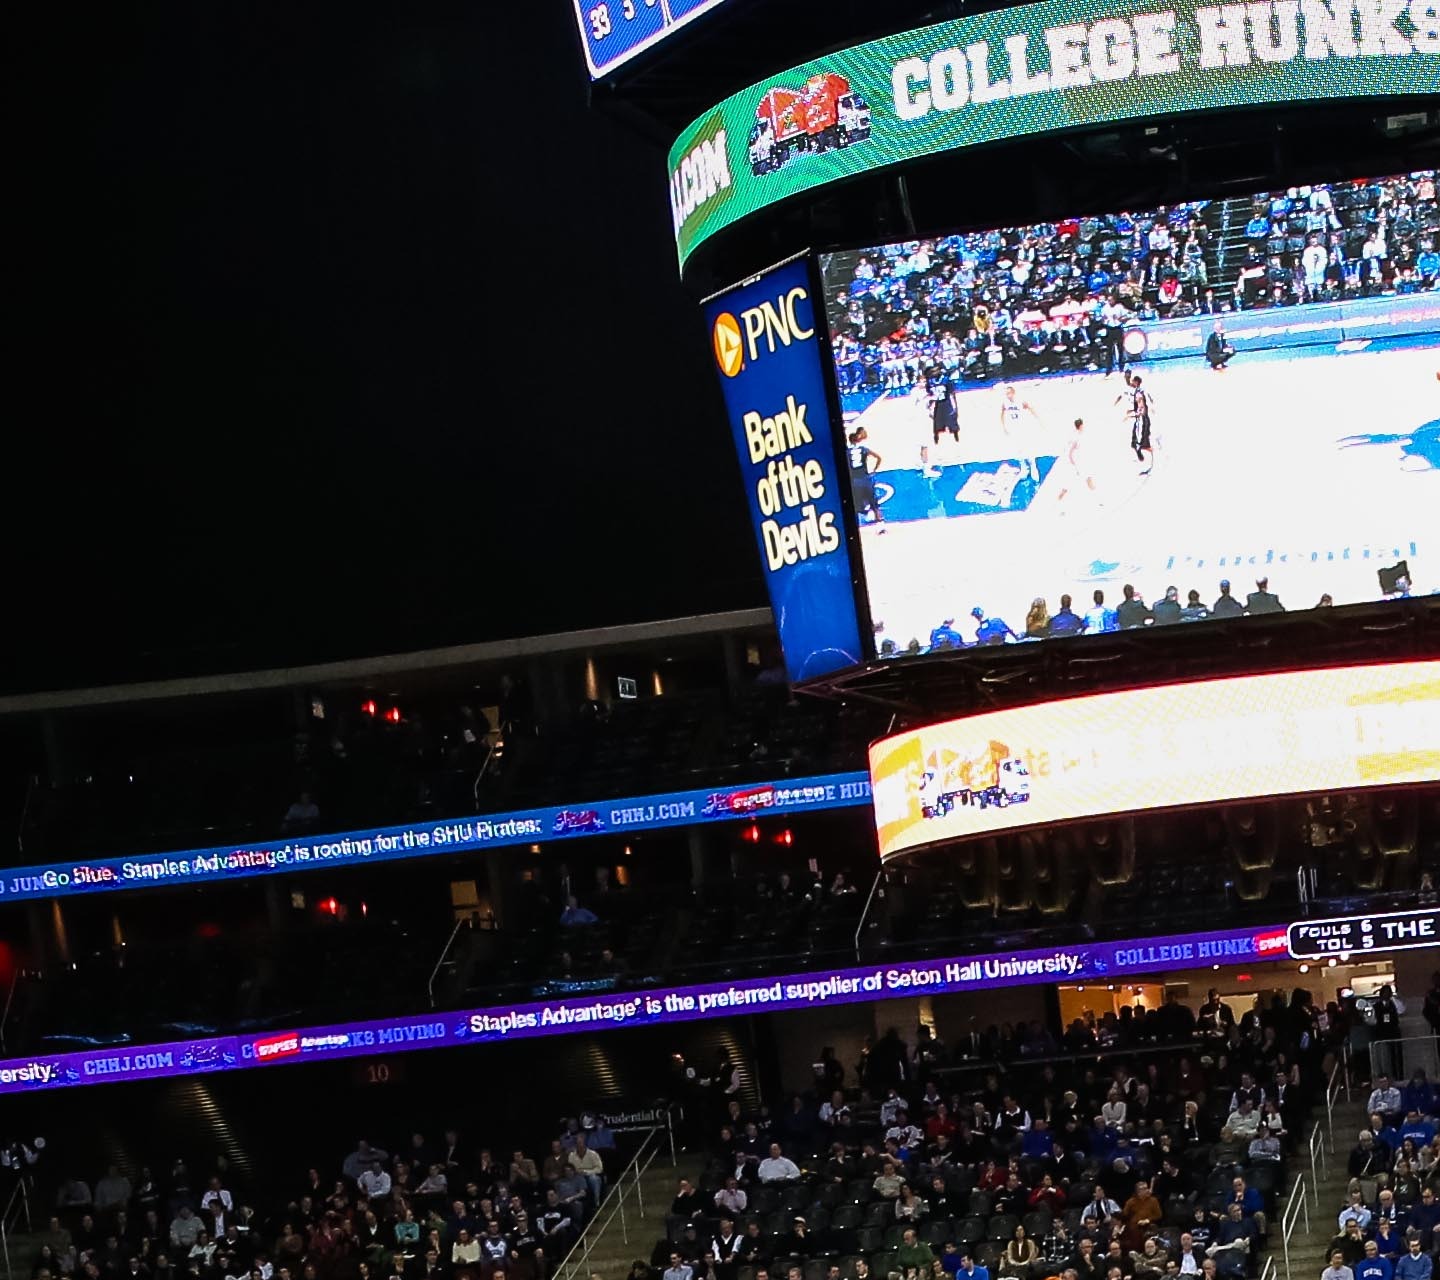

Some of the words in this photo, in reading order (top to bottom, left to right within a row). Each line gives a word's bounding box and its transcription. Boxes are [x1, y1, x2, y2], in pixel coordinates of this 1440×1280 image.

[892, 12, 1180, 122] COLLEGE
[741, 287, 814, 361] PNC
[743, 394, 813, 465] Bank
[758, 461, 781, 517] of
[777, 455, 825, 509] the
[761, 504, 839, 572] Devils
[611, 802, 695, 825] CHHJ.COM
[123, 859, 189, 882] Staples
[294, 843, 309, 860] is
[313, 836, 373, 860] rooting
[375, 832, 399, 852] for
[402, 830, 430, 849] the
[434, 825, 472, 845] SHU
[1299, 924, 1351, 939] FOULS
[1361, 919, 1373, 933] 6
[1316, 937, 1352, 950] TOL
[1362, 935, 1374, 949] 5
[1381, 921, 1434, 938] THE
[470, 1010, 537, 1034] Staples
[646, 994, 662, 1013] is
[665, 992, 694, 1011] the
[699, 983, 782, 1011] preferred
[786, 977, 859, 1003] supplier
[863, 973, 882, 991] of
[886, 968, 941, 989] Seton
[946, 963, 981, 983] Hall
[984, 953, 1083, 978] University.
[368, 1065, 390, 1083] 10
